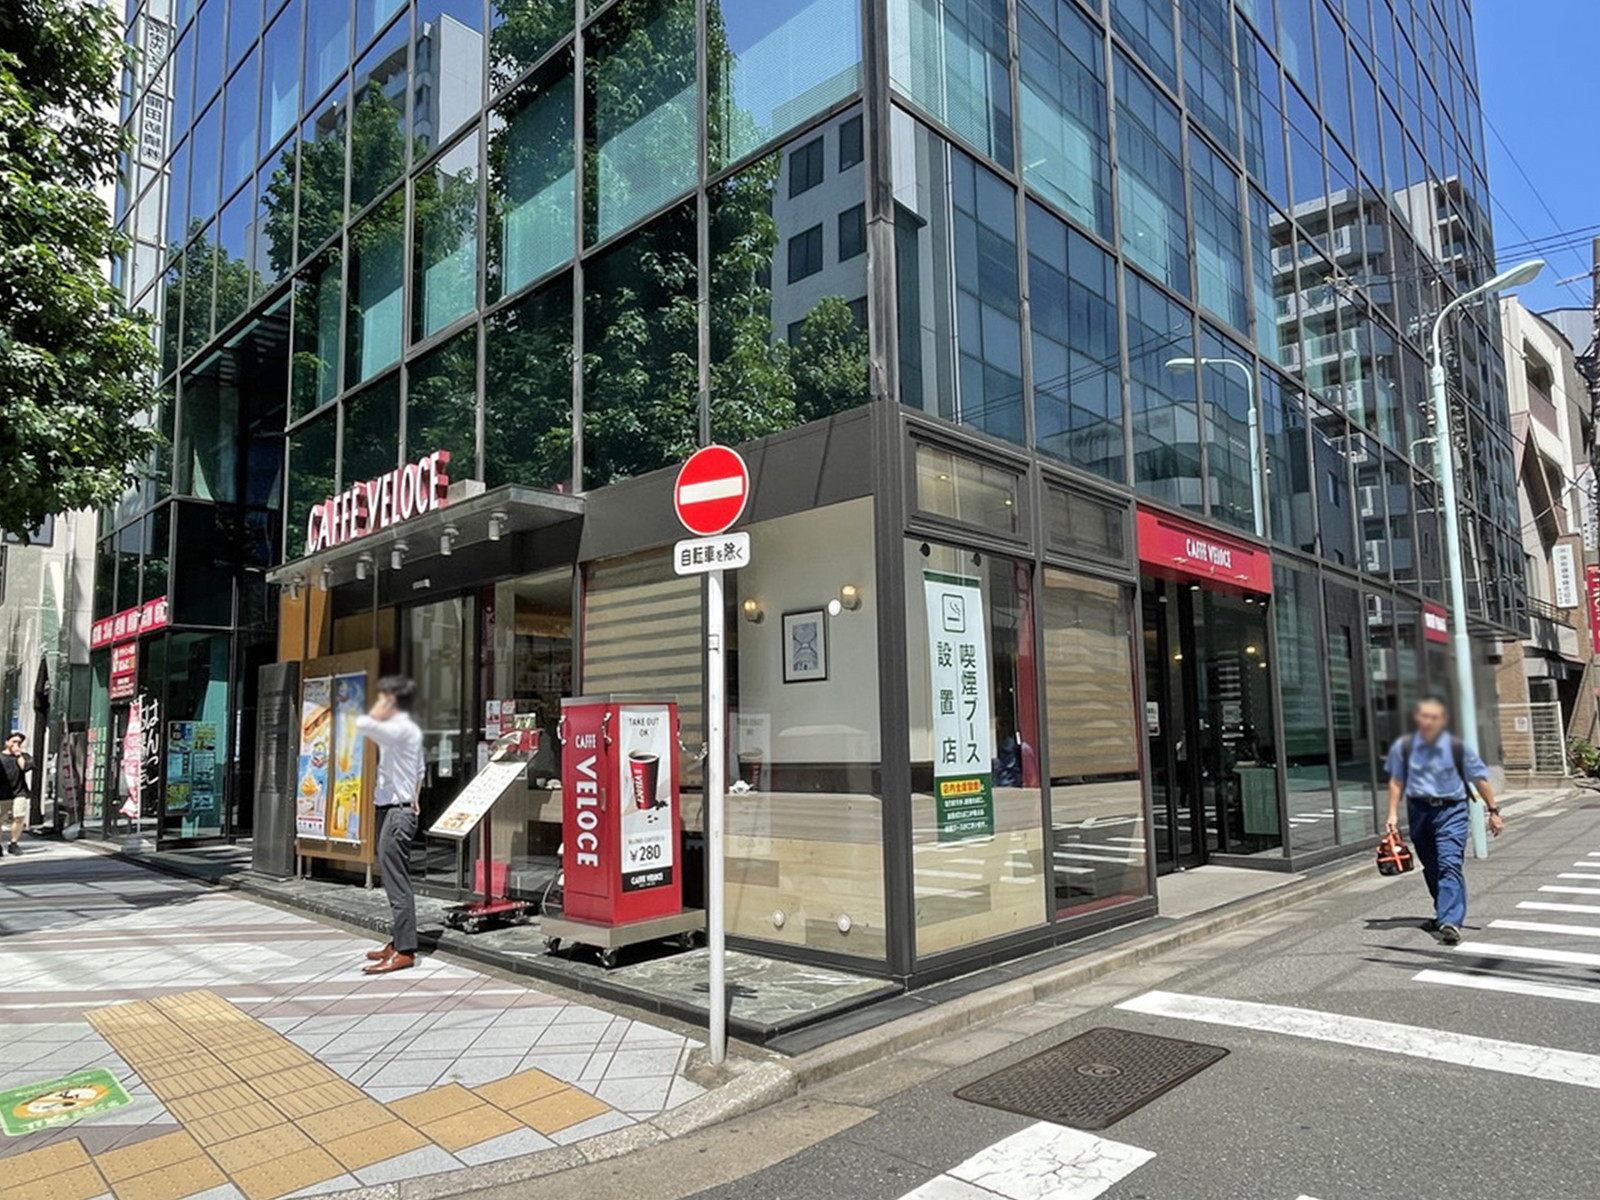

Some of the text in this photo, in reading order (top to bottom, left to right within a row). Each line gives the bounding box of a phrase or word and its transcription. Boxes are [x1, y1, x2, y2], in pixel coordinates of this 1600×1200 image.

[367, 452, 447, 531] VELOCE
[681, 542, 743, 566] 自転車を除く
[628, 716, 660, 726] TAKE OUT
[937, 641, 957, 764] 設置店
[959, 644, 980, 764] 喫煙ブース
[575, 755, 600, 868] VELOCE
[629, 844, 661, 862] ¥280
